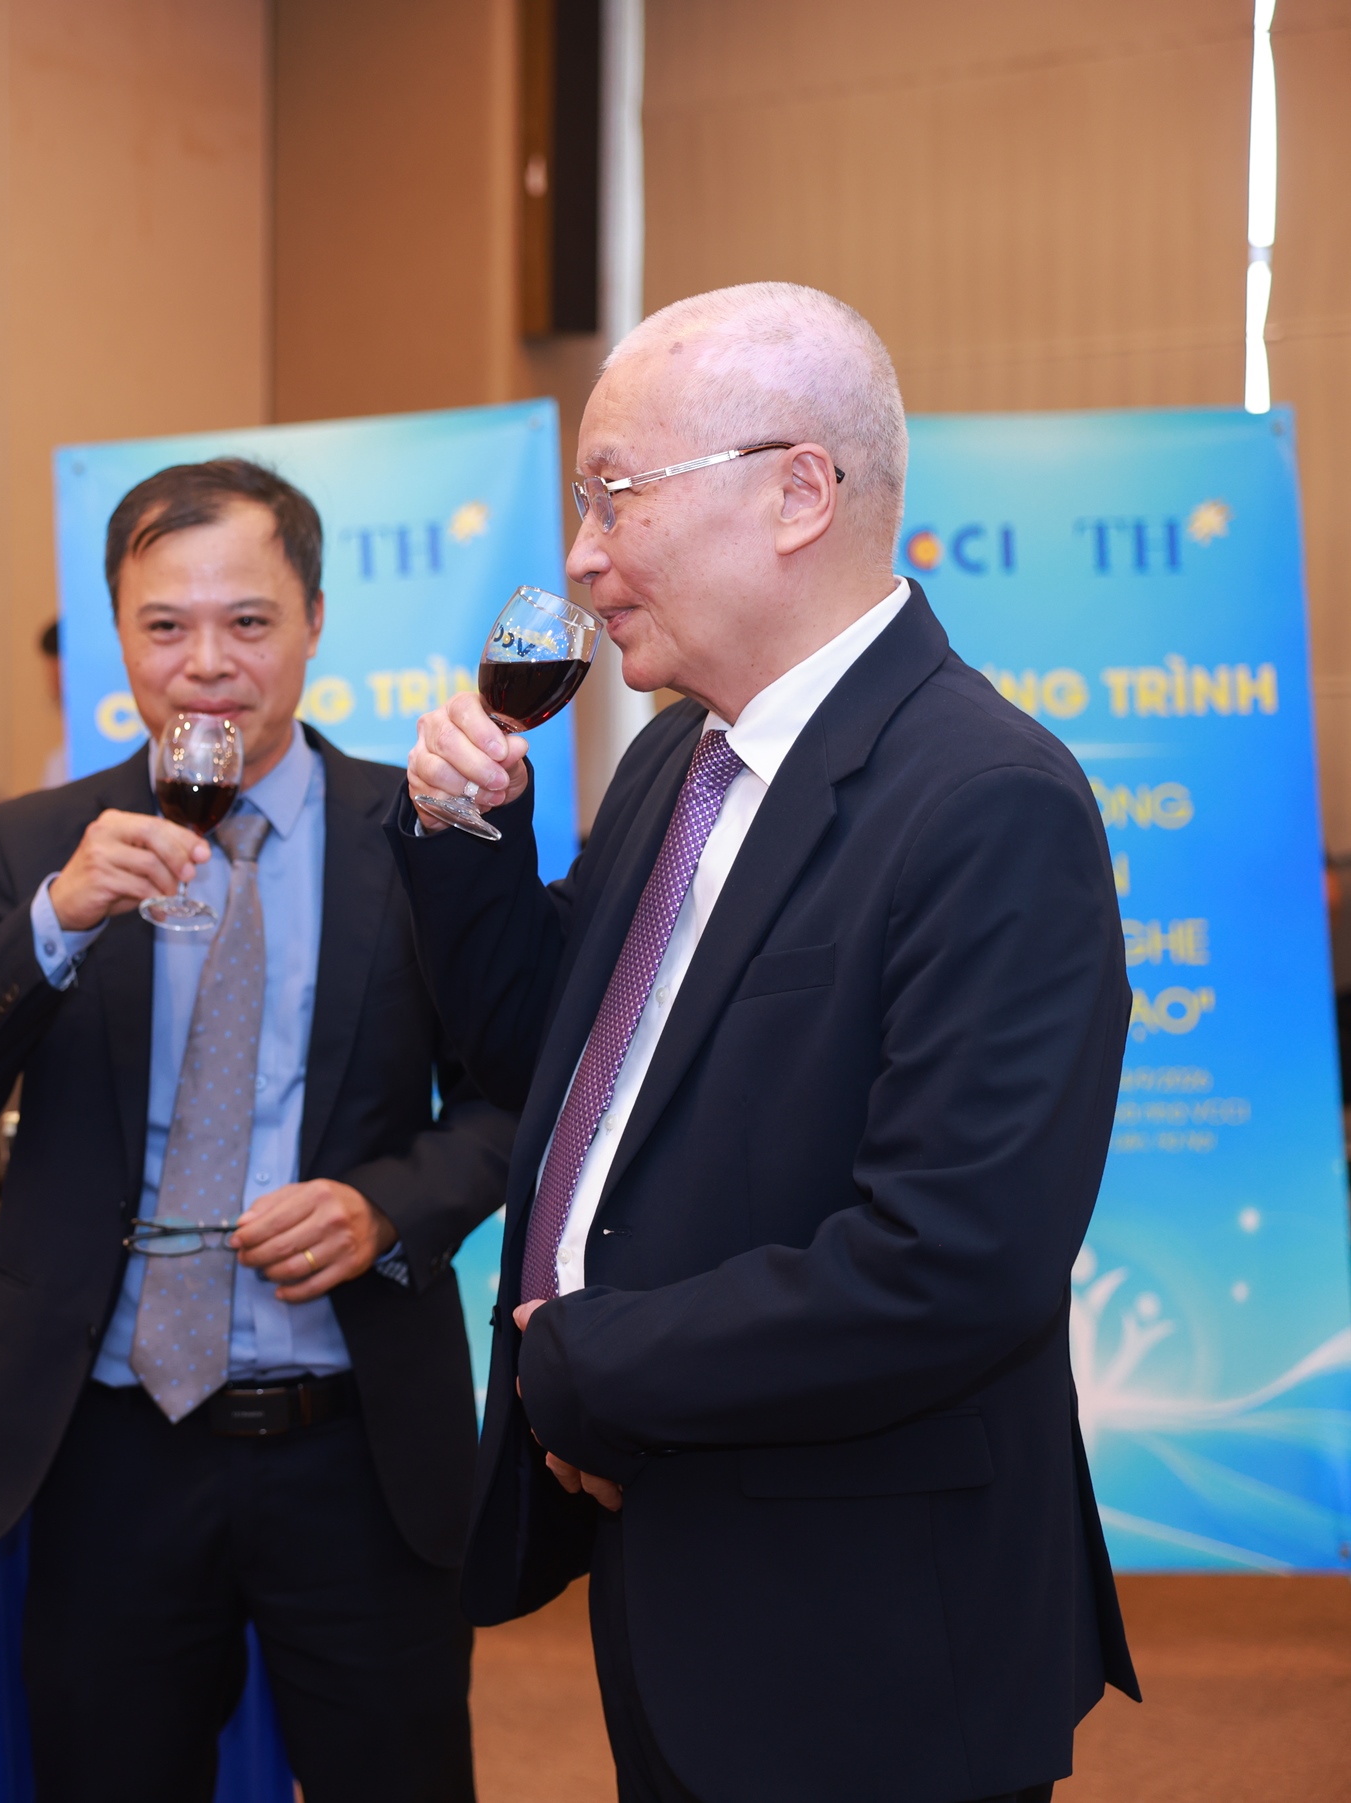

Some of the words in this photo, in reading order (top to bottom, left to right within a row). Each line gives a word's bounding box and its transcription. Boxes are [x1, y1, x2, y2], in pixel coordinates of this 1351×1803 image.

[340, 522, 444, 579] TH
[1075, 517, 1182, 574] TH
[1102, 653, 1278, 717] TRÌNH
